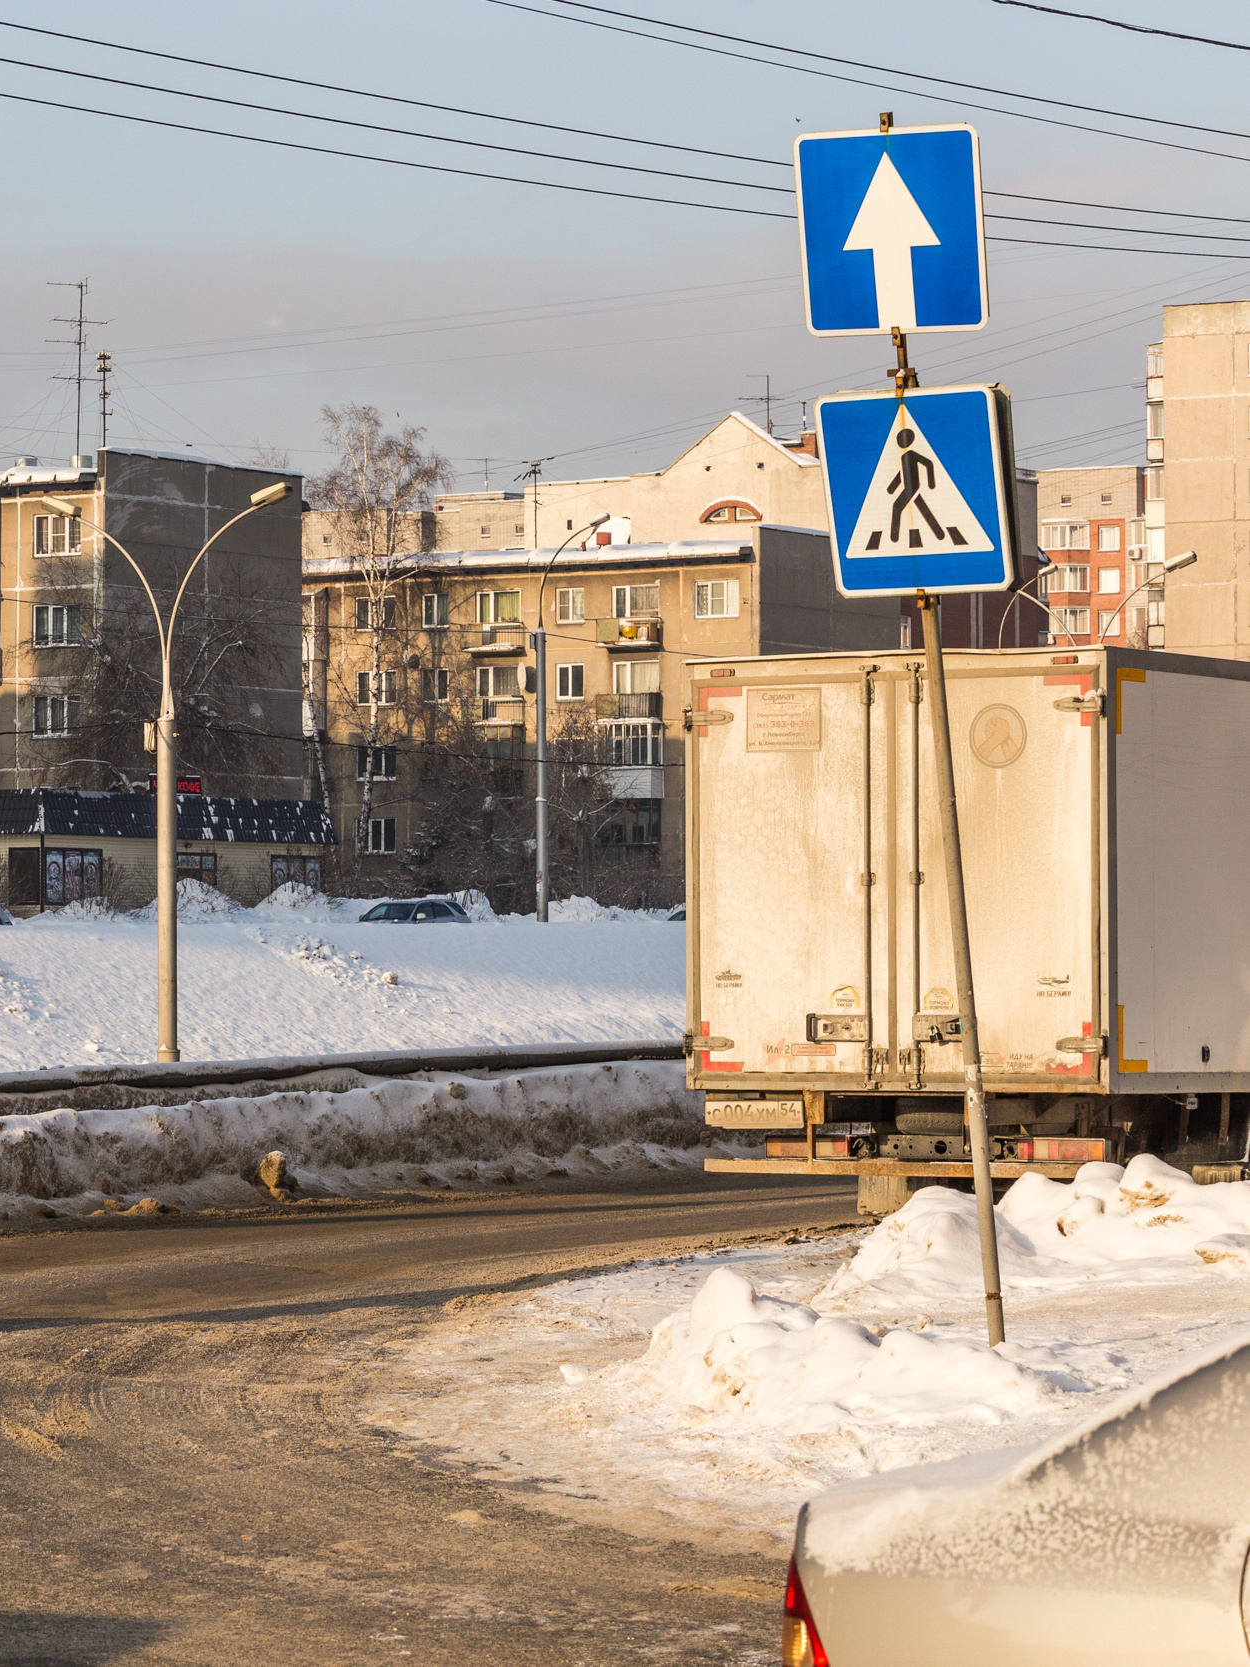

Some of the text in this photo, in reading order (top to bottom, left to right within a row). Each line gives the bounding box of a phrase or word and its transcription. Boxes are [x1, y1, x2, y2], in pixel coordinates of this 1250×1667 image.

[761, 692, 797, 703] Сармат
[770, 720, 815, 728] 363-0-363
[177, 781, 201, 793] КОФЕ
